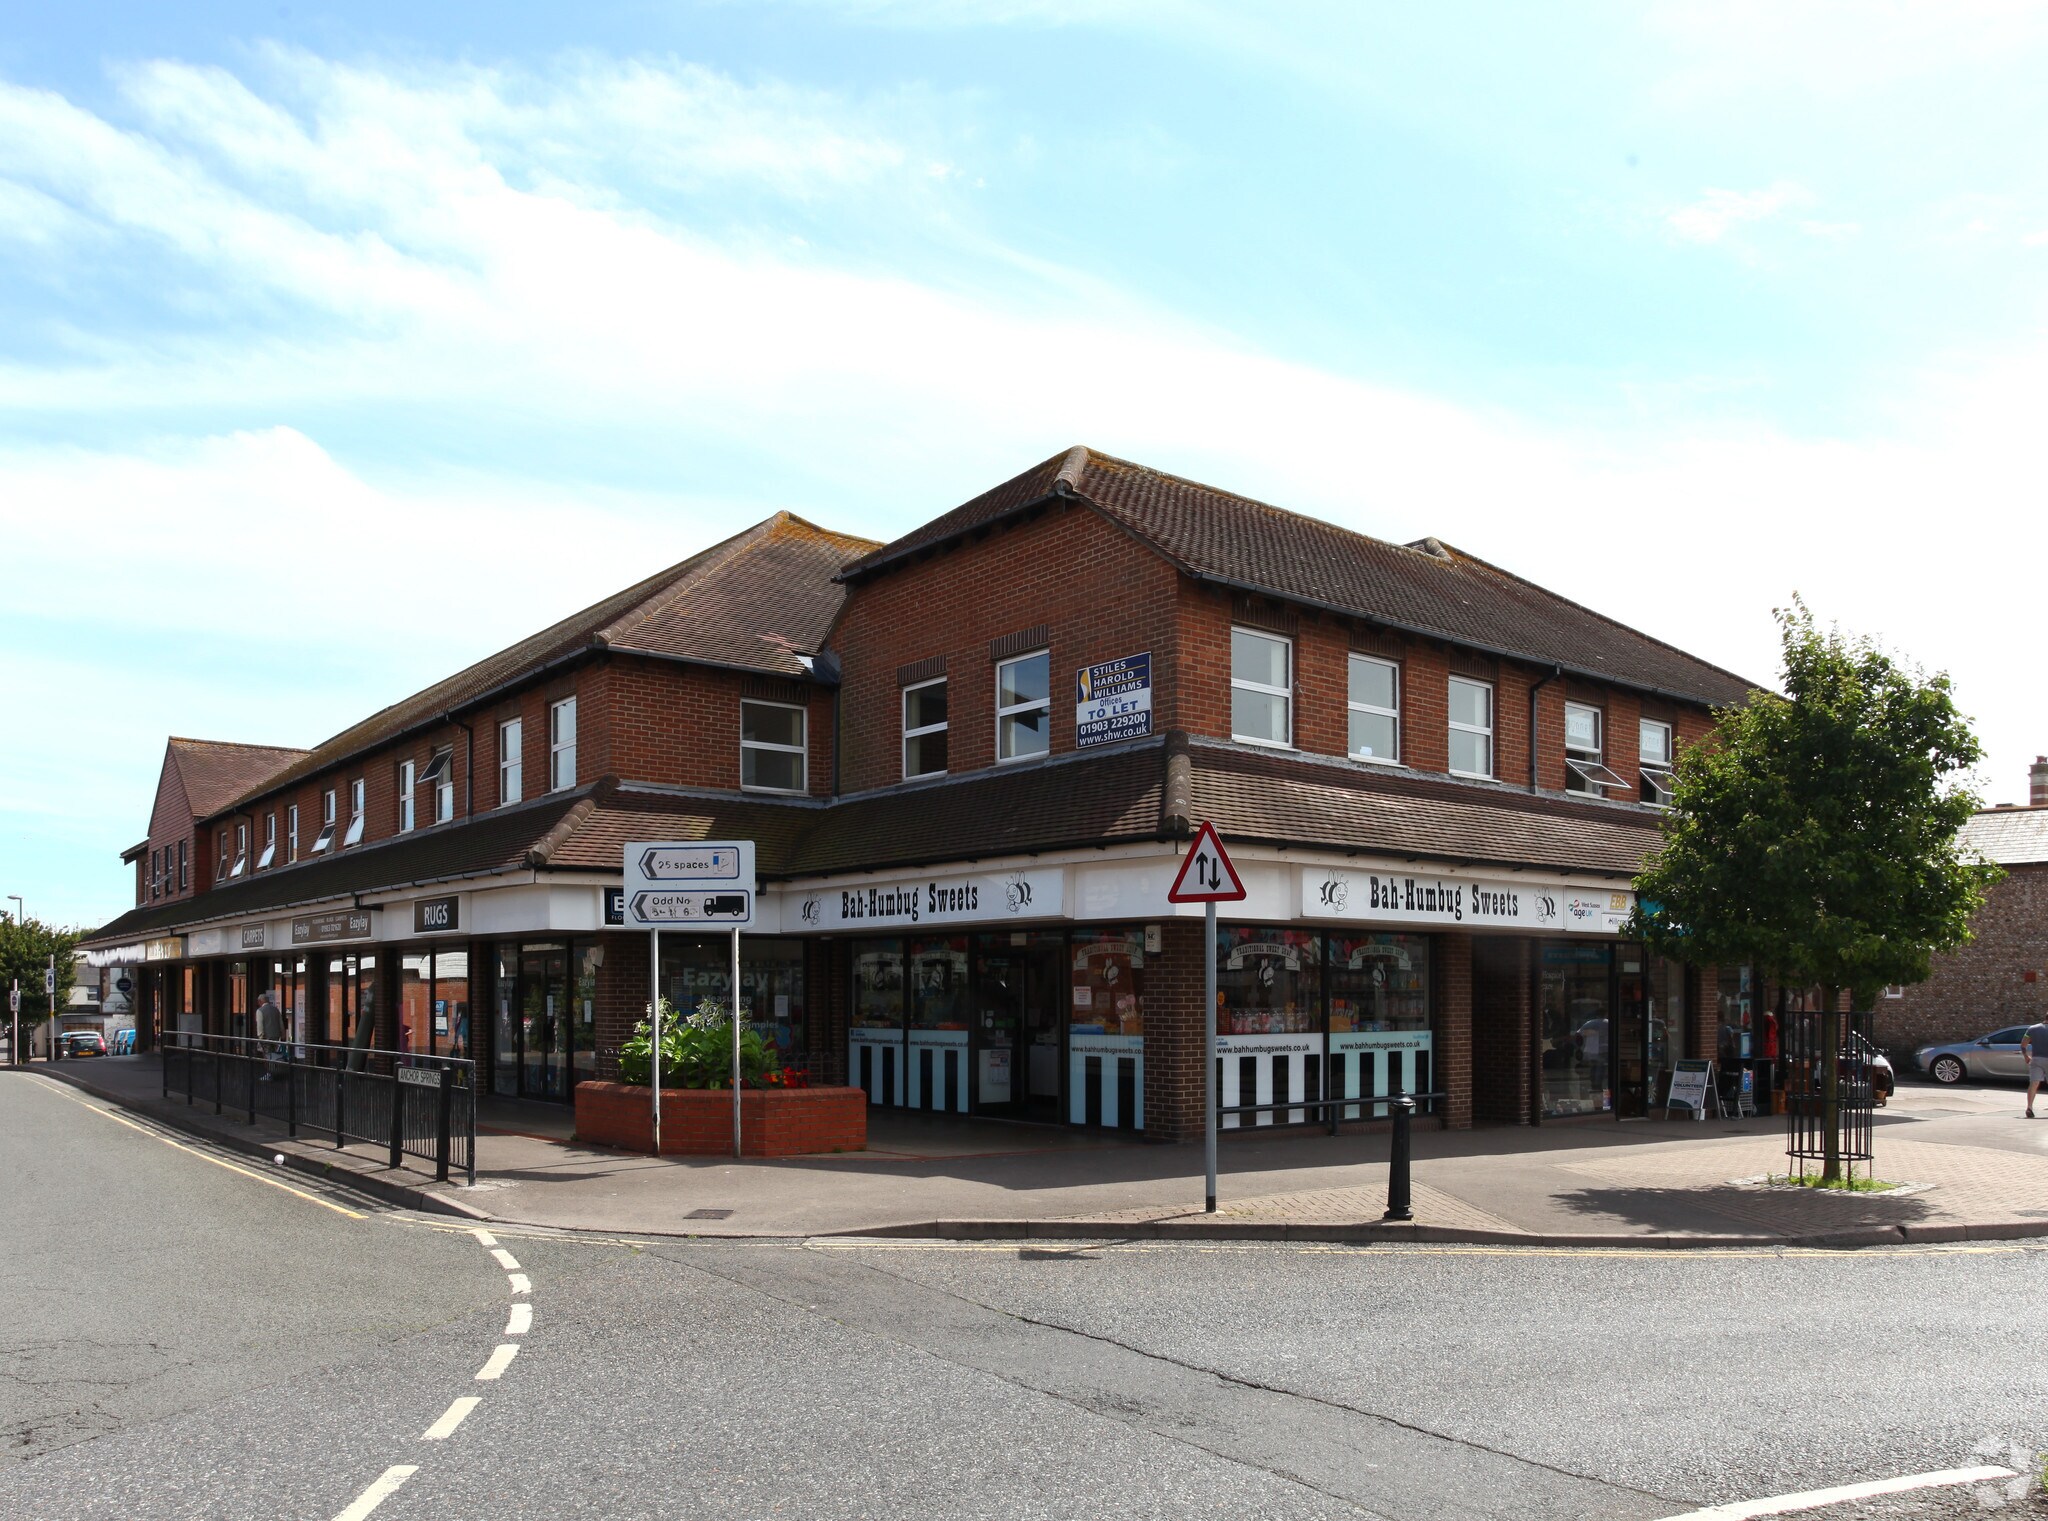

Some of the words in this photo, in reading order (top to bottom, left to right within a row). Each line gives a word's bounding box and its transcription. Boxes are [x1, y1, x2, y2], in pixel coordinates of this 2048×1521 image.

[1094, 661, 1126, 677] STILES
[1094, 671, 1134, 688] HAROLD
[1094, 680, 1142, 699] WILLIAMS
[1088, 708, 1106, 720] TO
[1112, 700, 1138, 715] LET
[1100, 696, 1122, 707] Offices
[1080, 721, 1108, 735] 01903
[1111, 712, 1146, 729] 229200
[1079, 723, 1147, 746] www.shw.co.uk
[658, 860, 671, 869] 25
[674, 861, 709, 871] spaces
[652, 896, 673, 905] Odd
[842, 886, 919, 922] Bah-Humbug
[928, 880, 978, 913] Sweets
[1370, 876, 1462, 921] Bah-Humbug
[1472, 883, 1519, 917] Sweets
[1610, 894, 1627, 911] EBB
[424, 904, 448, 926] RUGS
[243, 928, 263, 944] CARPETS
[682, 967, 769, 993] Eazyay
[1341, 1040, 1421, 1051] www.bahhumbugsweets.co.uk
[400, 1069, 419, 1082] ANCHOR
[420, 1071, 441, 1086] SPRINGS
